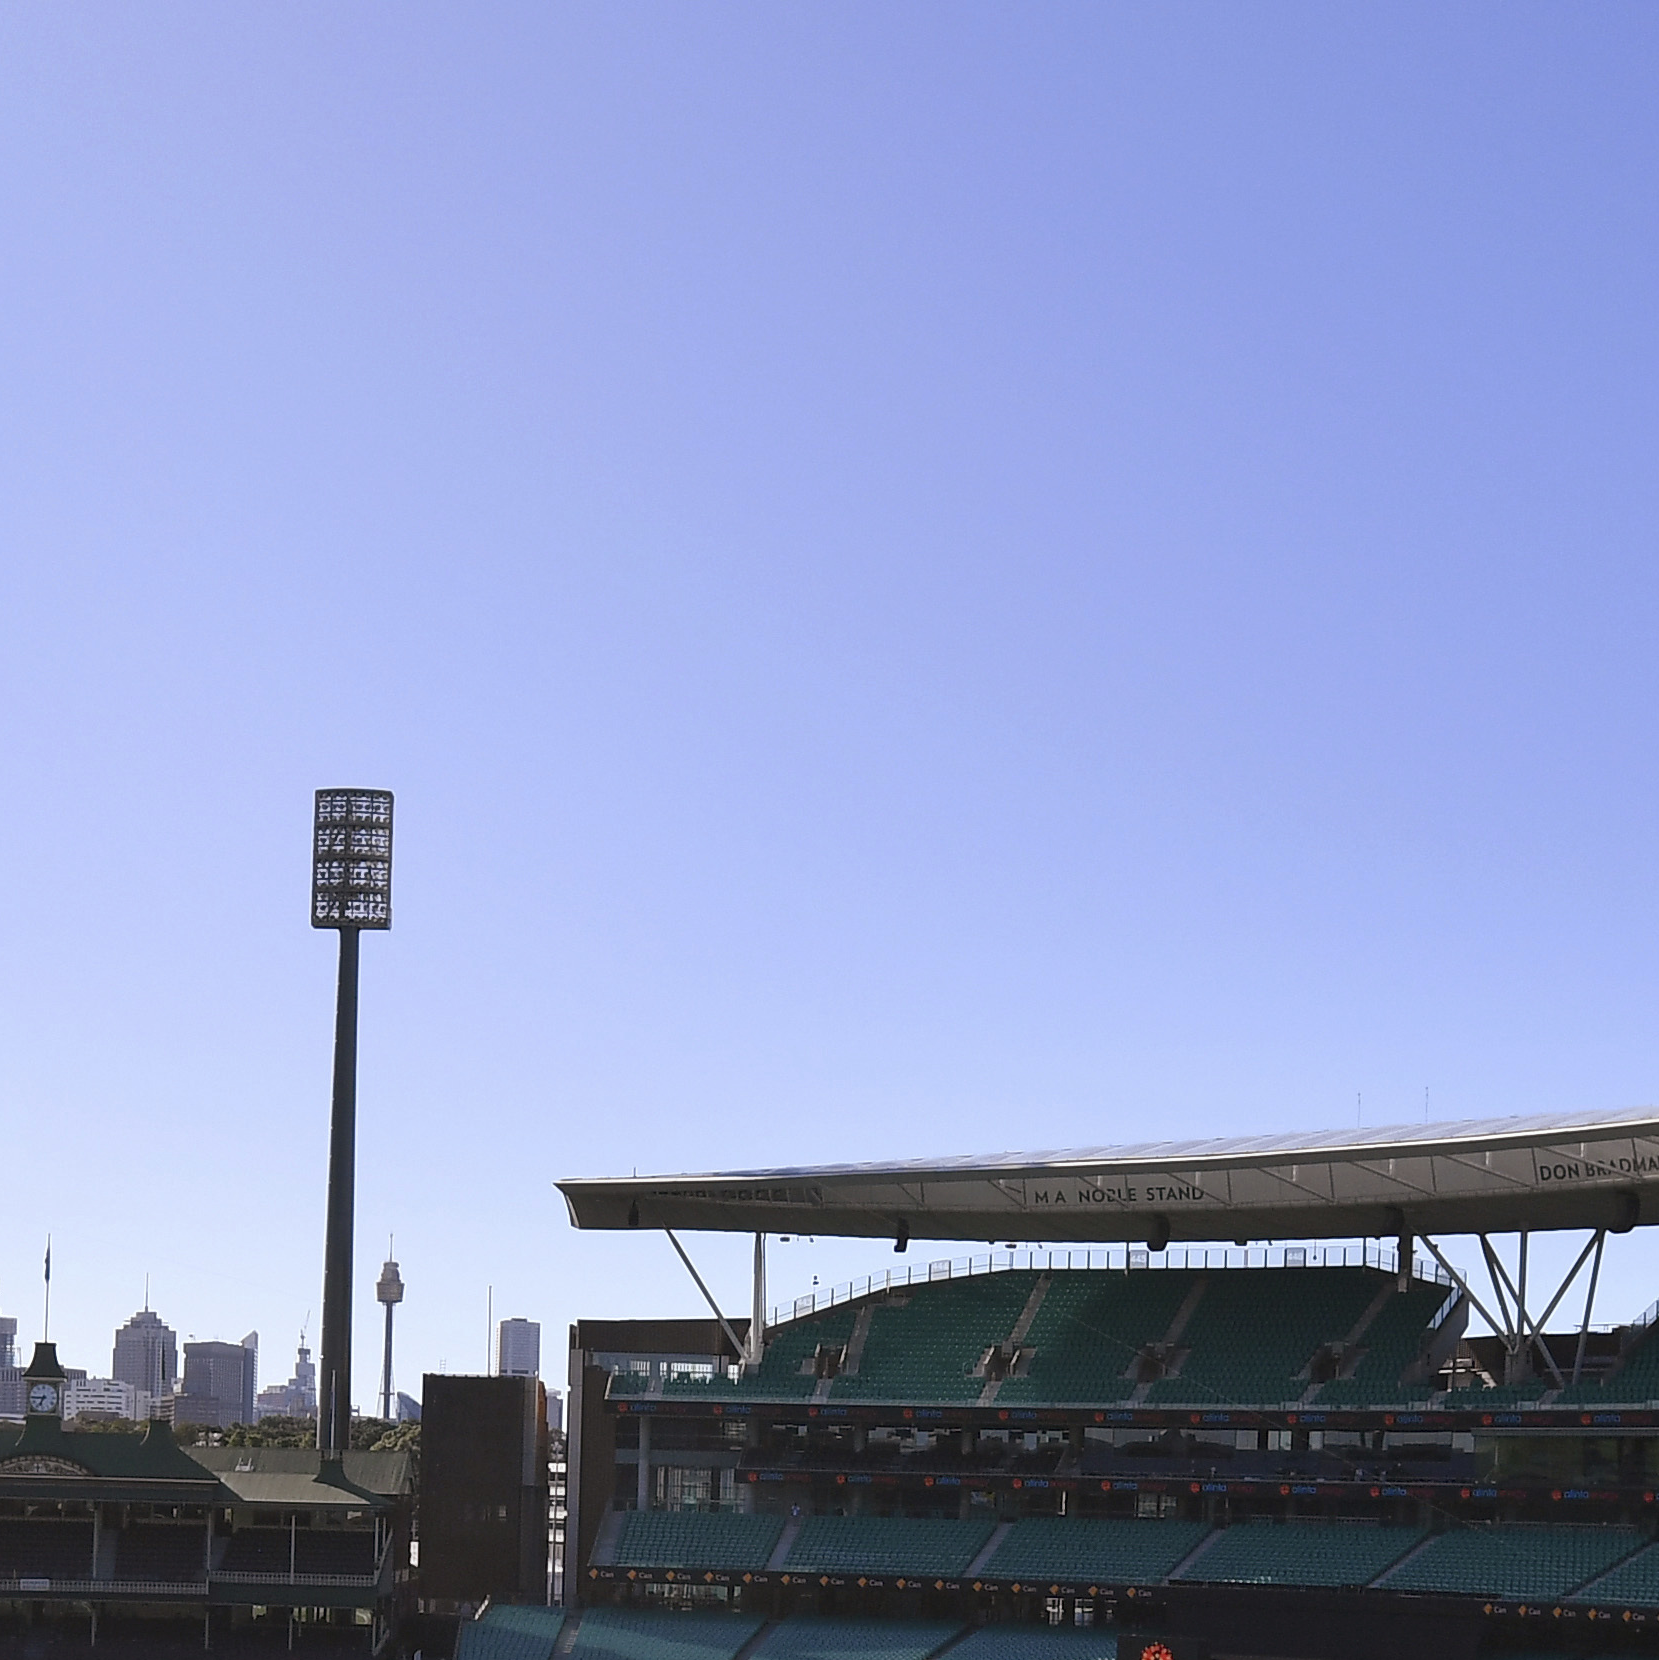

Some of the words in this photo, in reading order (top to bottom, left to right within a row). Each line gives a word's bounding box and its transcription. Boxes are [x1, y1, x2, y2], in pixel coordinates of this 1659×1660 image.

[1540, 1164, 1580, 1181] DON
[1034, 1191, 1049, 1204] M
[1079, 1188, 1137, 1203] NOBLE
[1147, 1186, 1205, 1201] STAND
